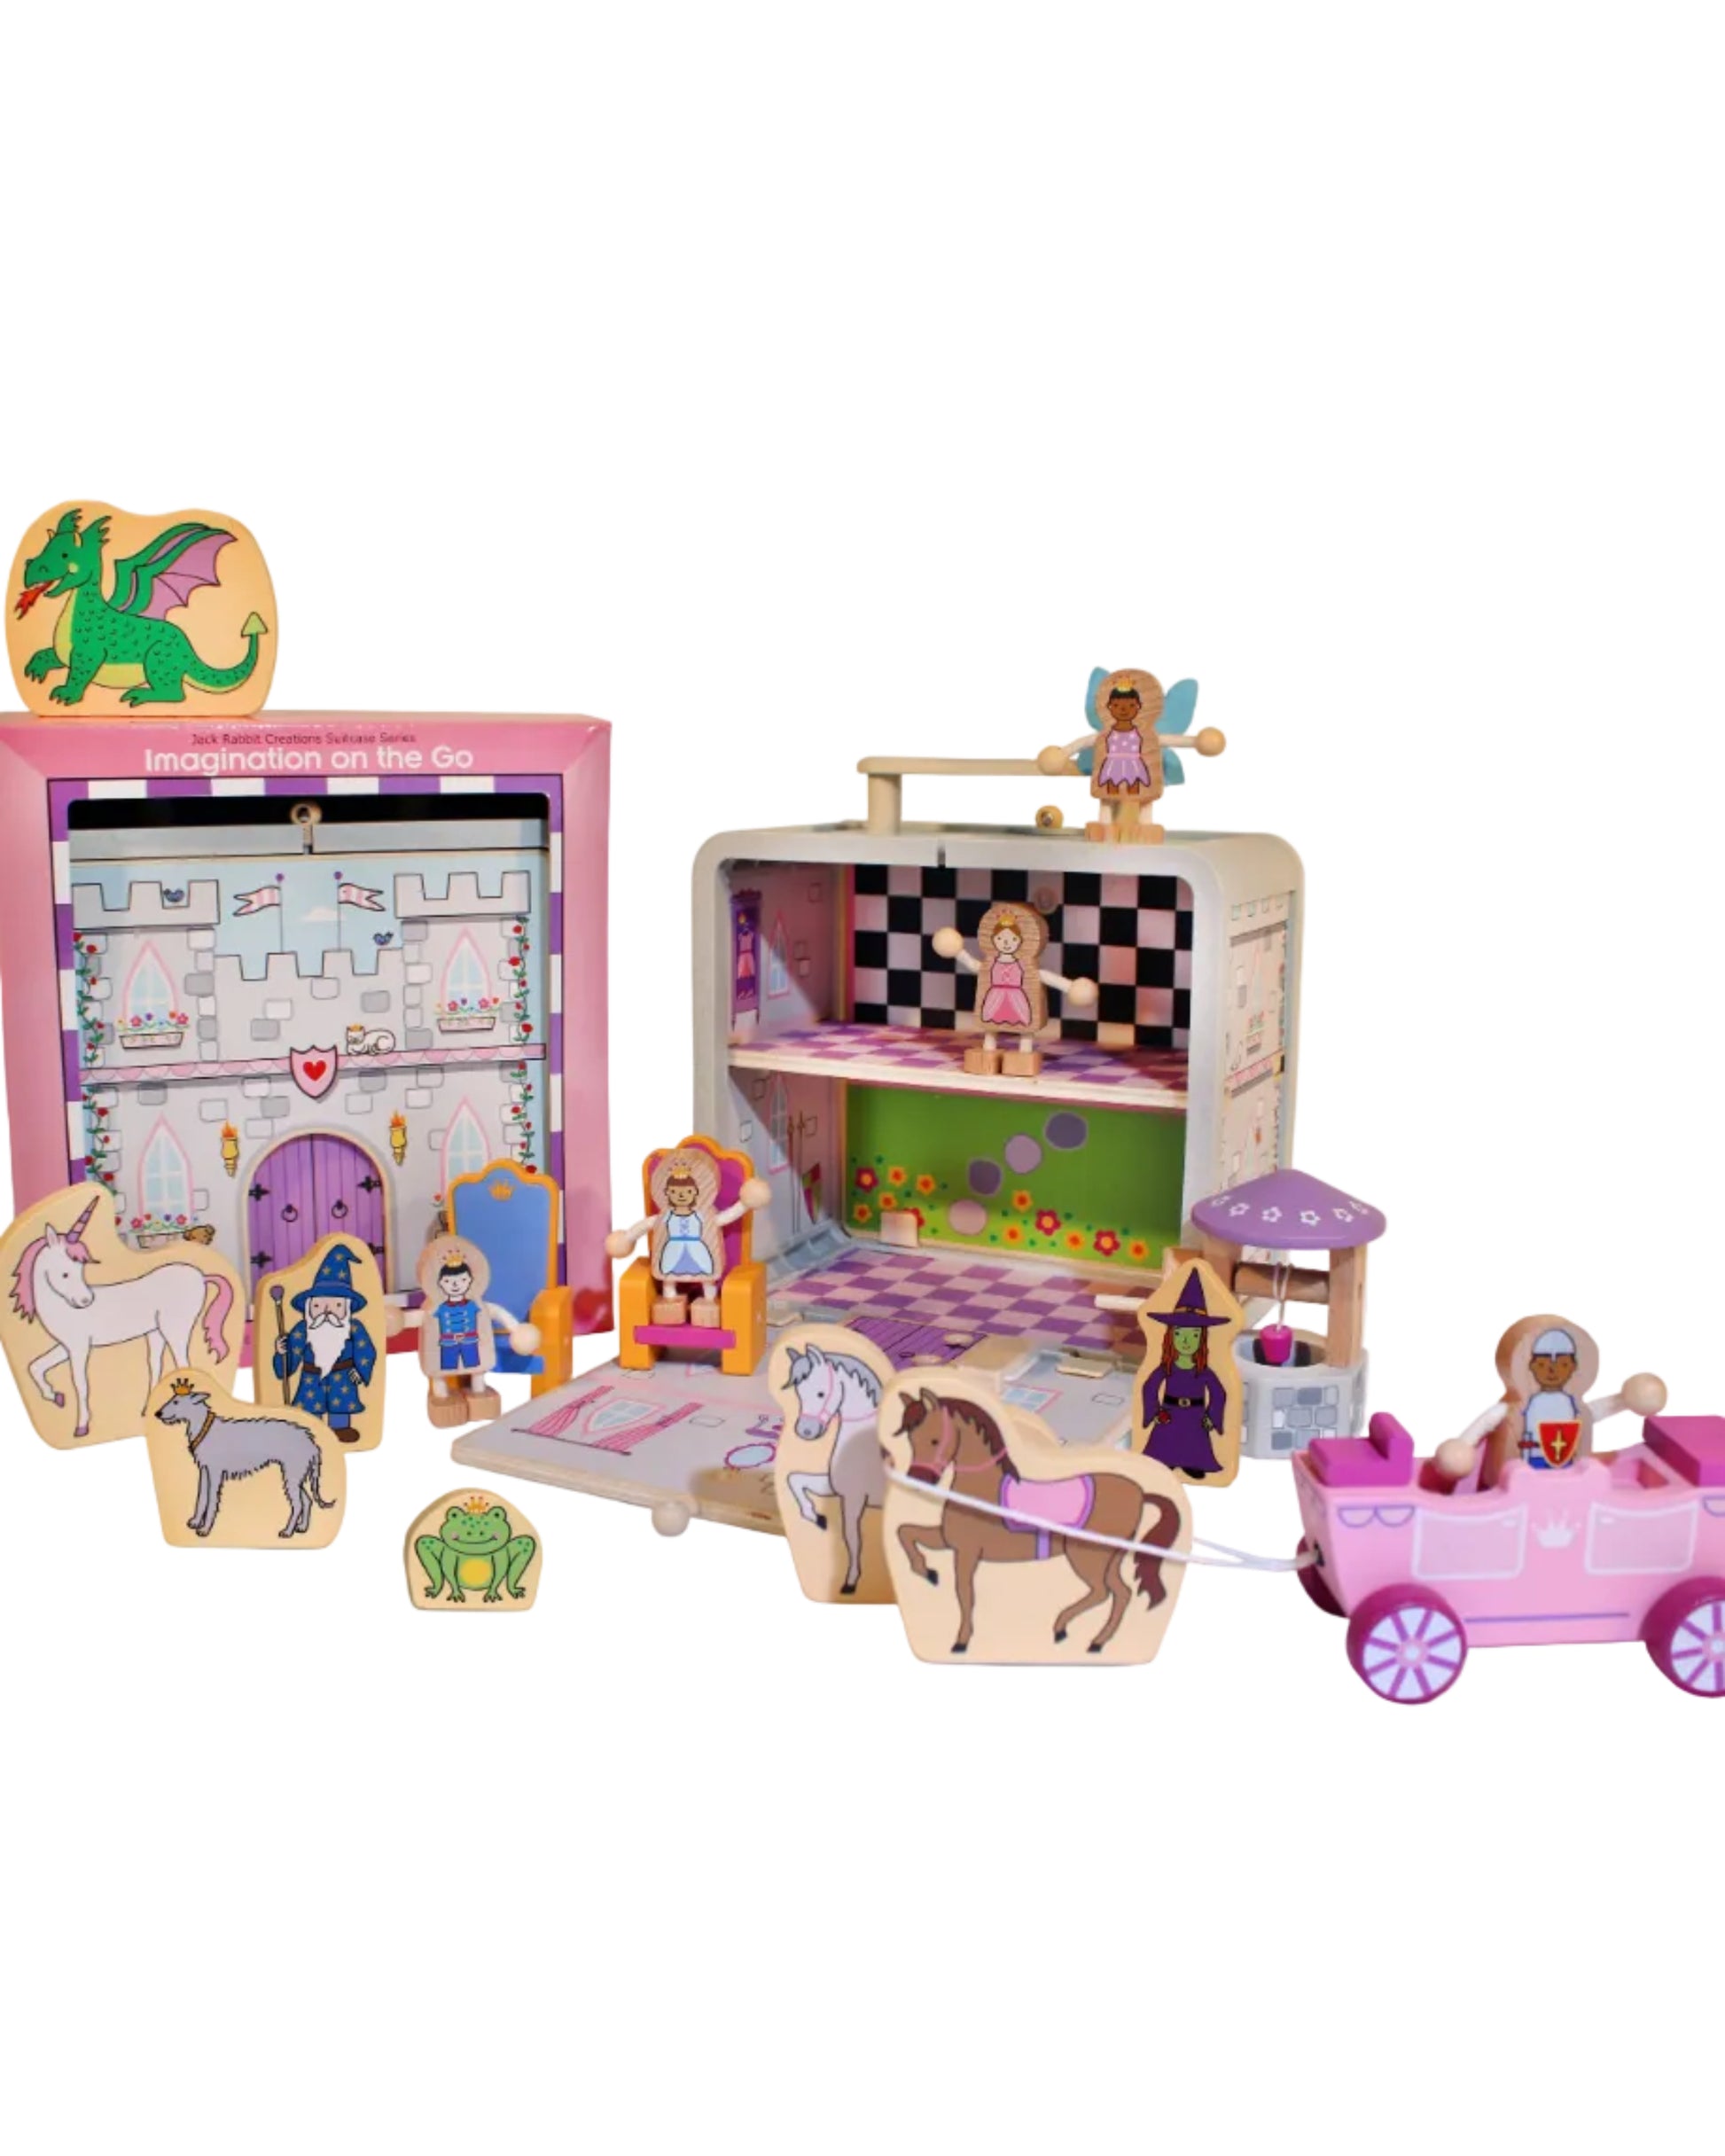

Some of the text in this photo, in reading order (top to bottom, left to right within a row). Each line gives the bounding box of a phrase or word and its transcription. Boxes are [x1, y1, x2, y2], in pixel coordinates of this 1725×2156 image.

[191, 733, 218, 746] Jack
[222, 733, 261, 746] Rabbit
[265, 733, 322, 746] Creations
[379, 731, 416, 744] Series
[144, 745, 473, 777] Imagination on the Go
